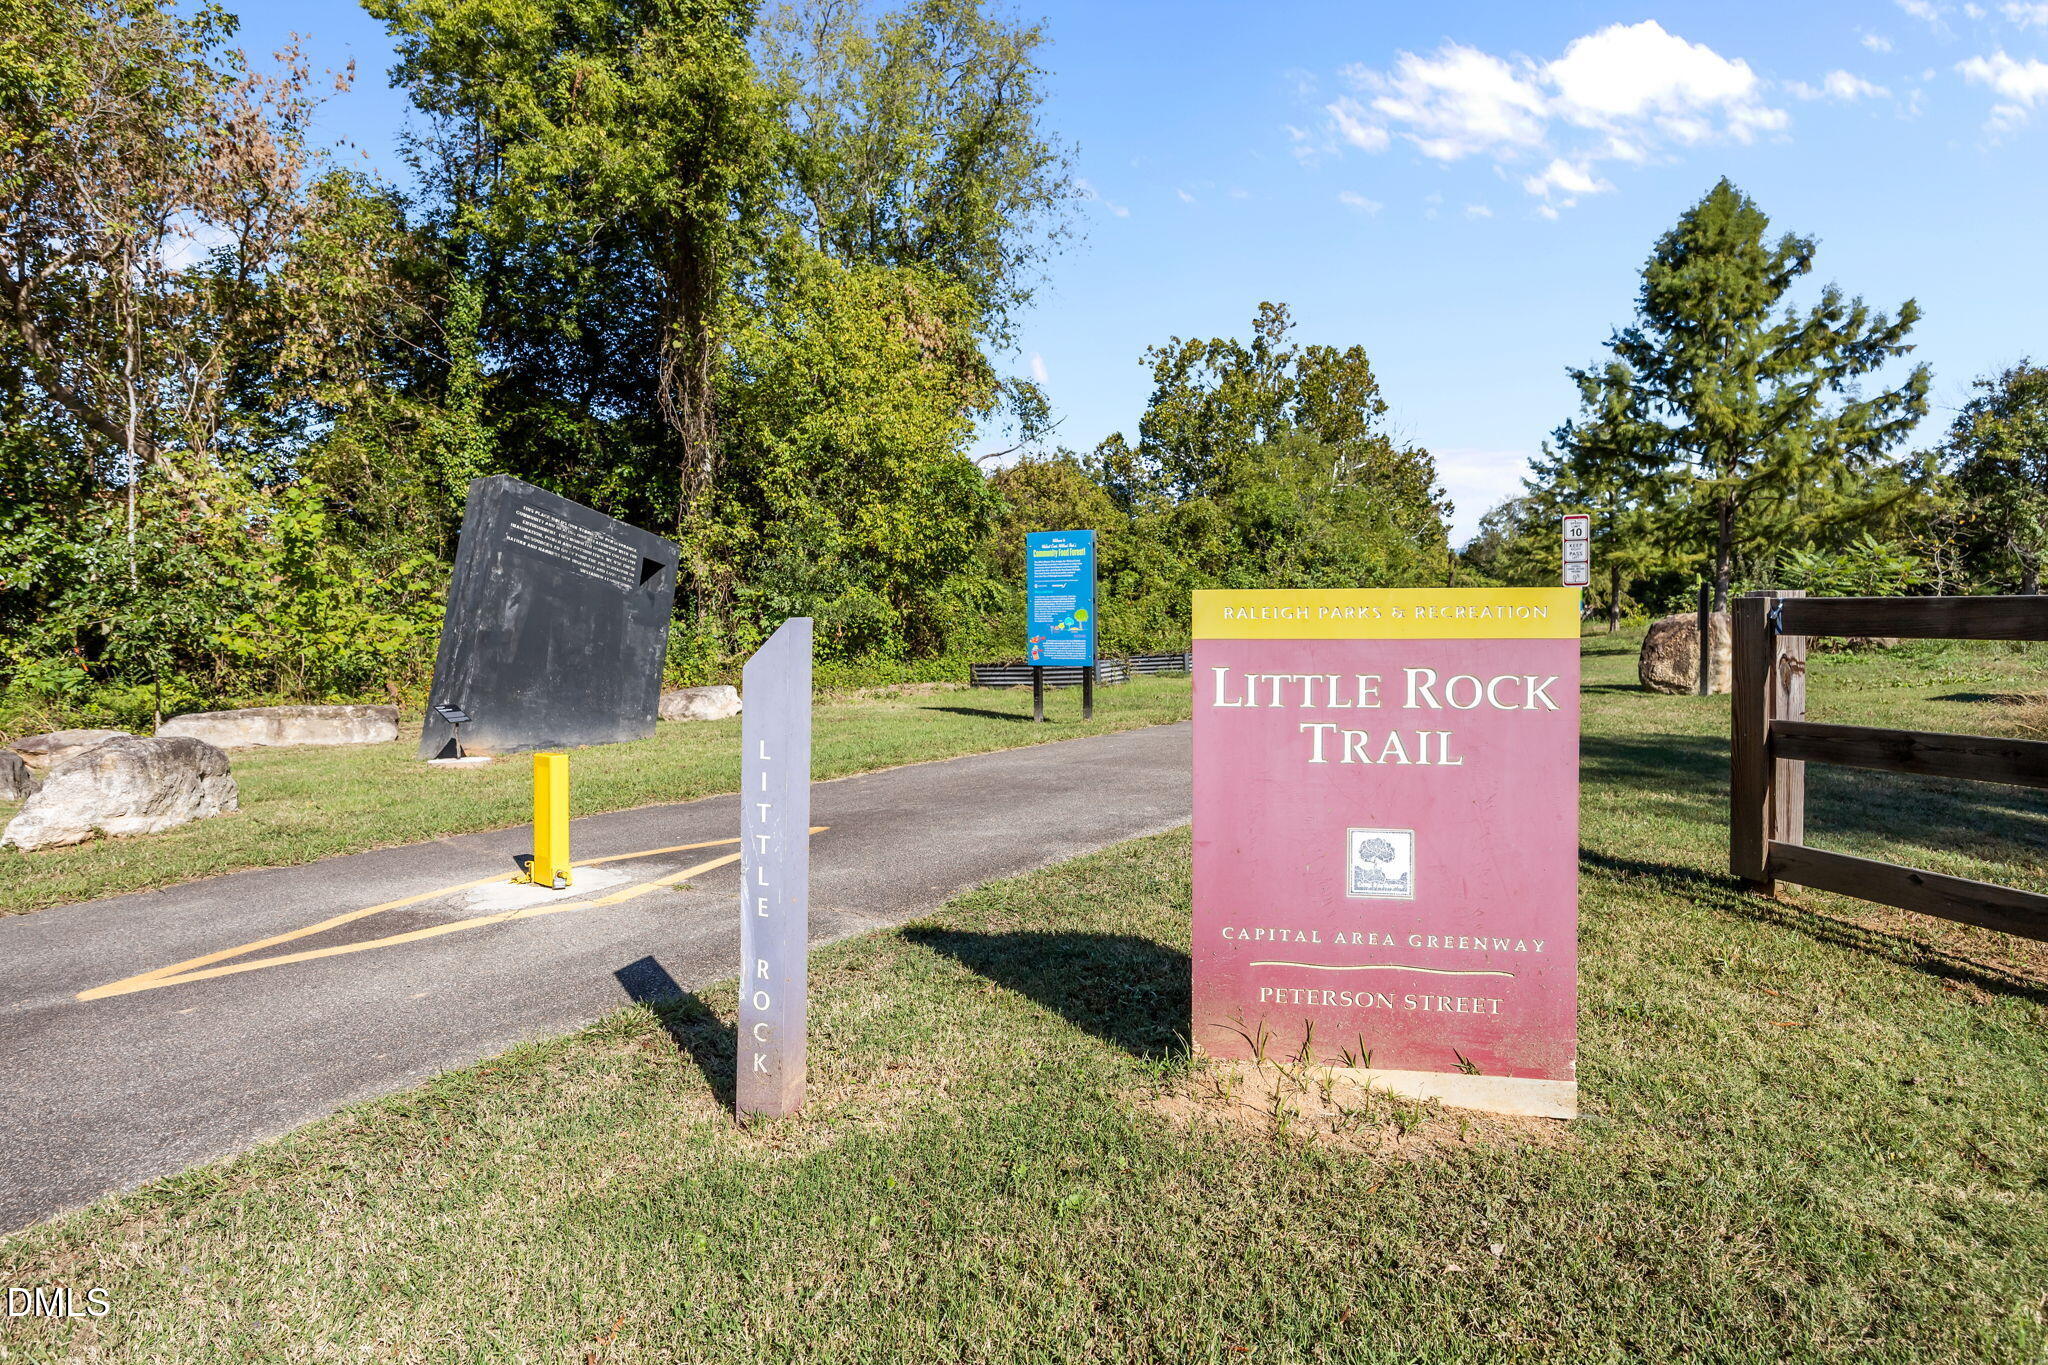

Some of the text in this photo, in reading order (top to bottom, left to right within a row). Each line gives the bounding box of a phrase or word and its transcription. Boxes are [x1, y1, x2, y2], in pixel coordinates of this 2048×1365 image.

[1570, 528, 1582, 536] 10
[1058, 548, 1069, 556] Food
[1223, 605, 1548, 620] RALEIGH PARKS & RECREATION
[1210, 666, 1561, 712] LITTLE ROCK
[1299, 722, 1464, 767] TRAIL
[752, 740, 772, 1074] LITTLE ROCK
[1222, 926, 1546, 954] CAPITAL AREA GREENWAY
[1259, 986, 1504, 1015] PETERSON STREET
